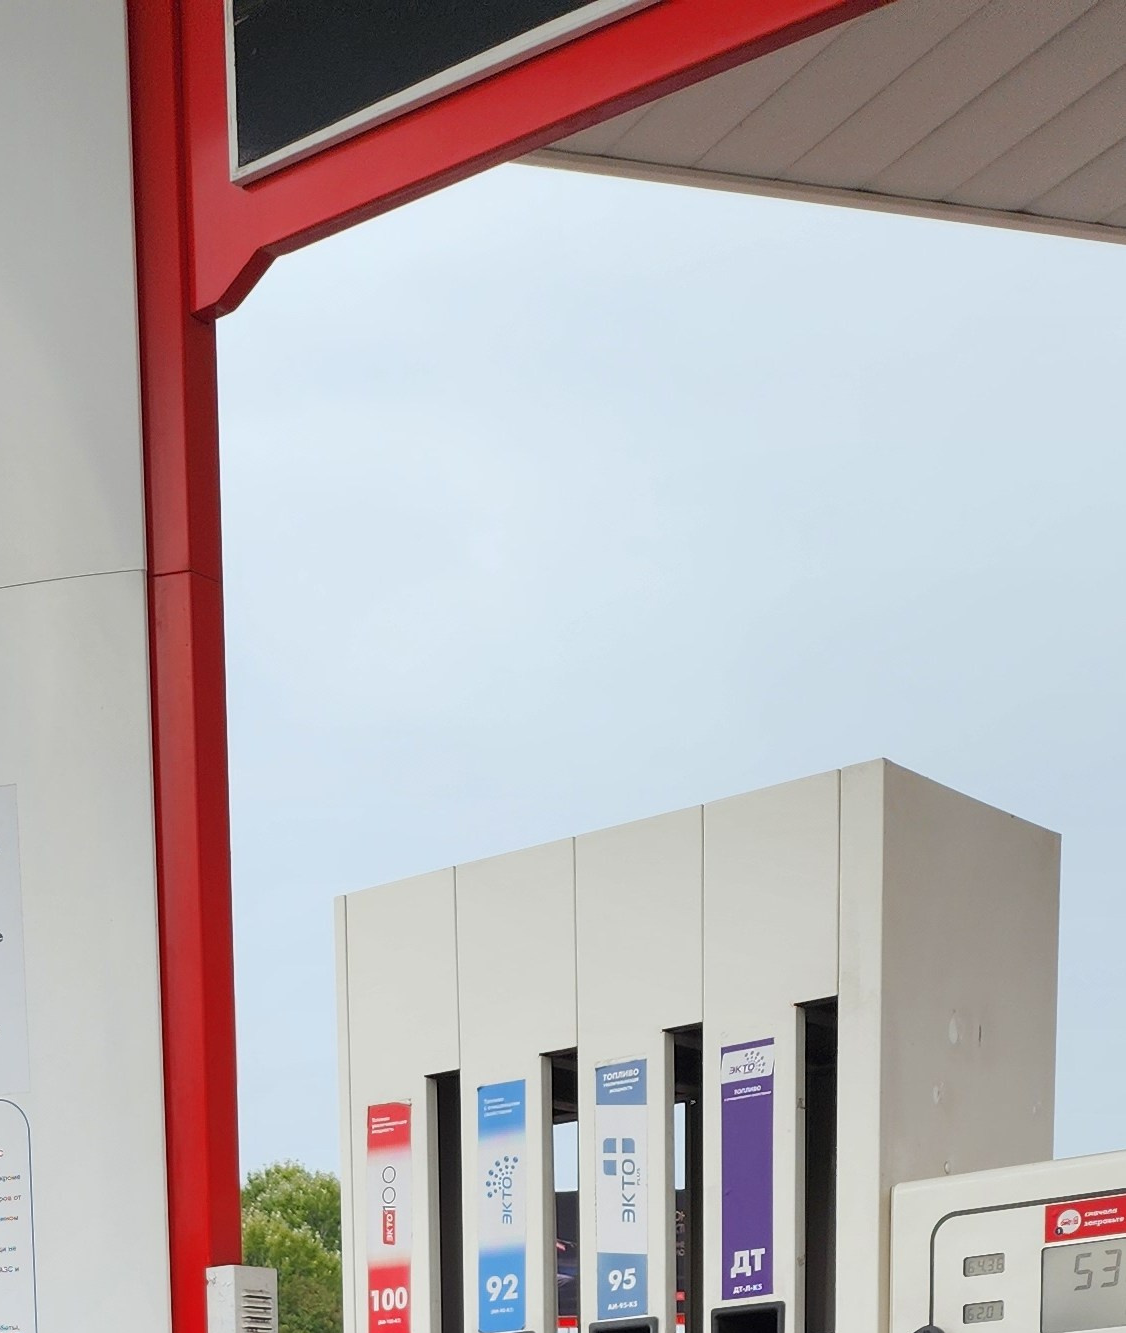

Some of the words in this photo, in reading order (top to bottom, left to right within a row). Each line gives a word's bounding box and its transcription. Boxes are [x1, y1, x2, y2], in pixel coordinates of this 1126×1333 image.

[603, 1068, 640, 1081] ТОПЛИВО
[729, 1062, 755, 1075] ЭКТО
[502, 1176, 512, 1224] ЭКТО
[622, 1159, 635, 1223] ЭКТО
[730, 1248, 765, 1278] ДТ
[486, 1273, 518, 1302] 92
[608, 1268, 636, 1292] 95
[370, 1286, 408, 1312] 100
